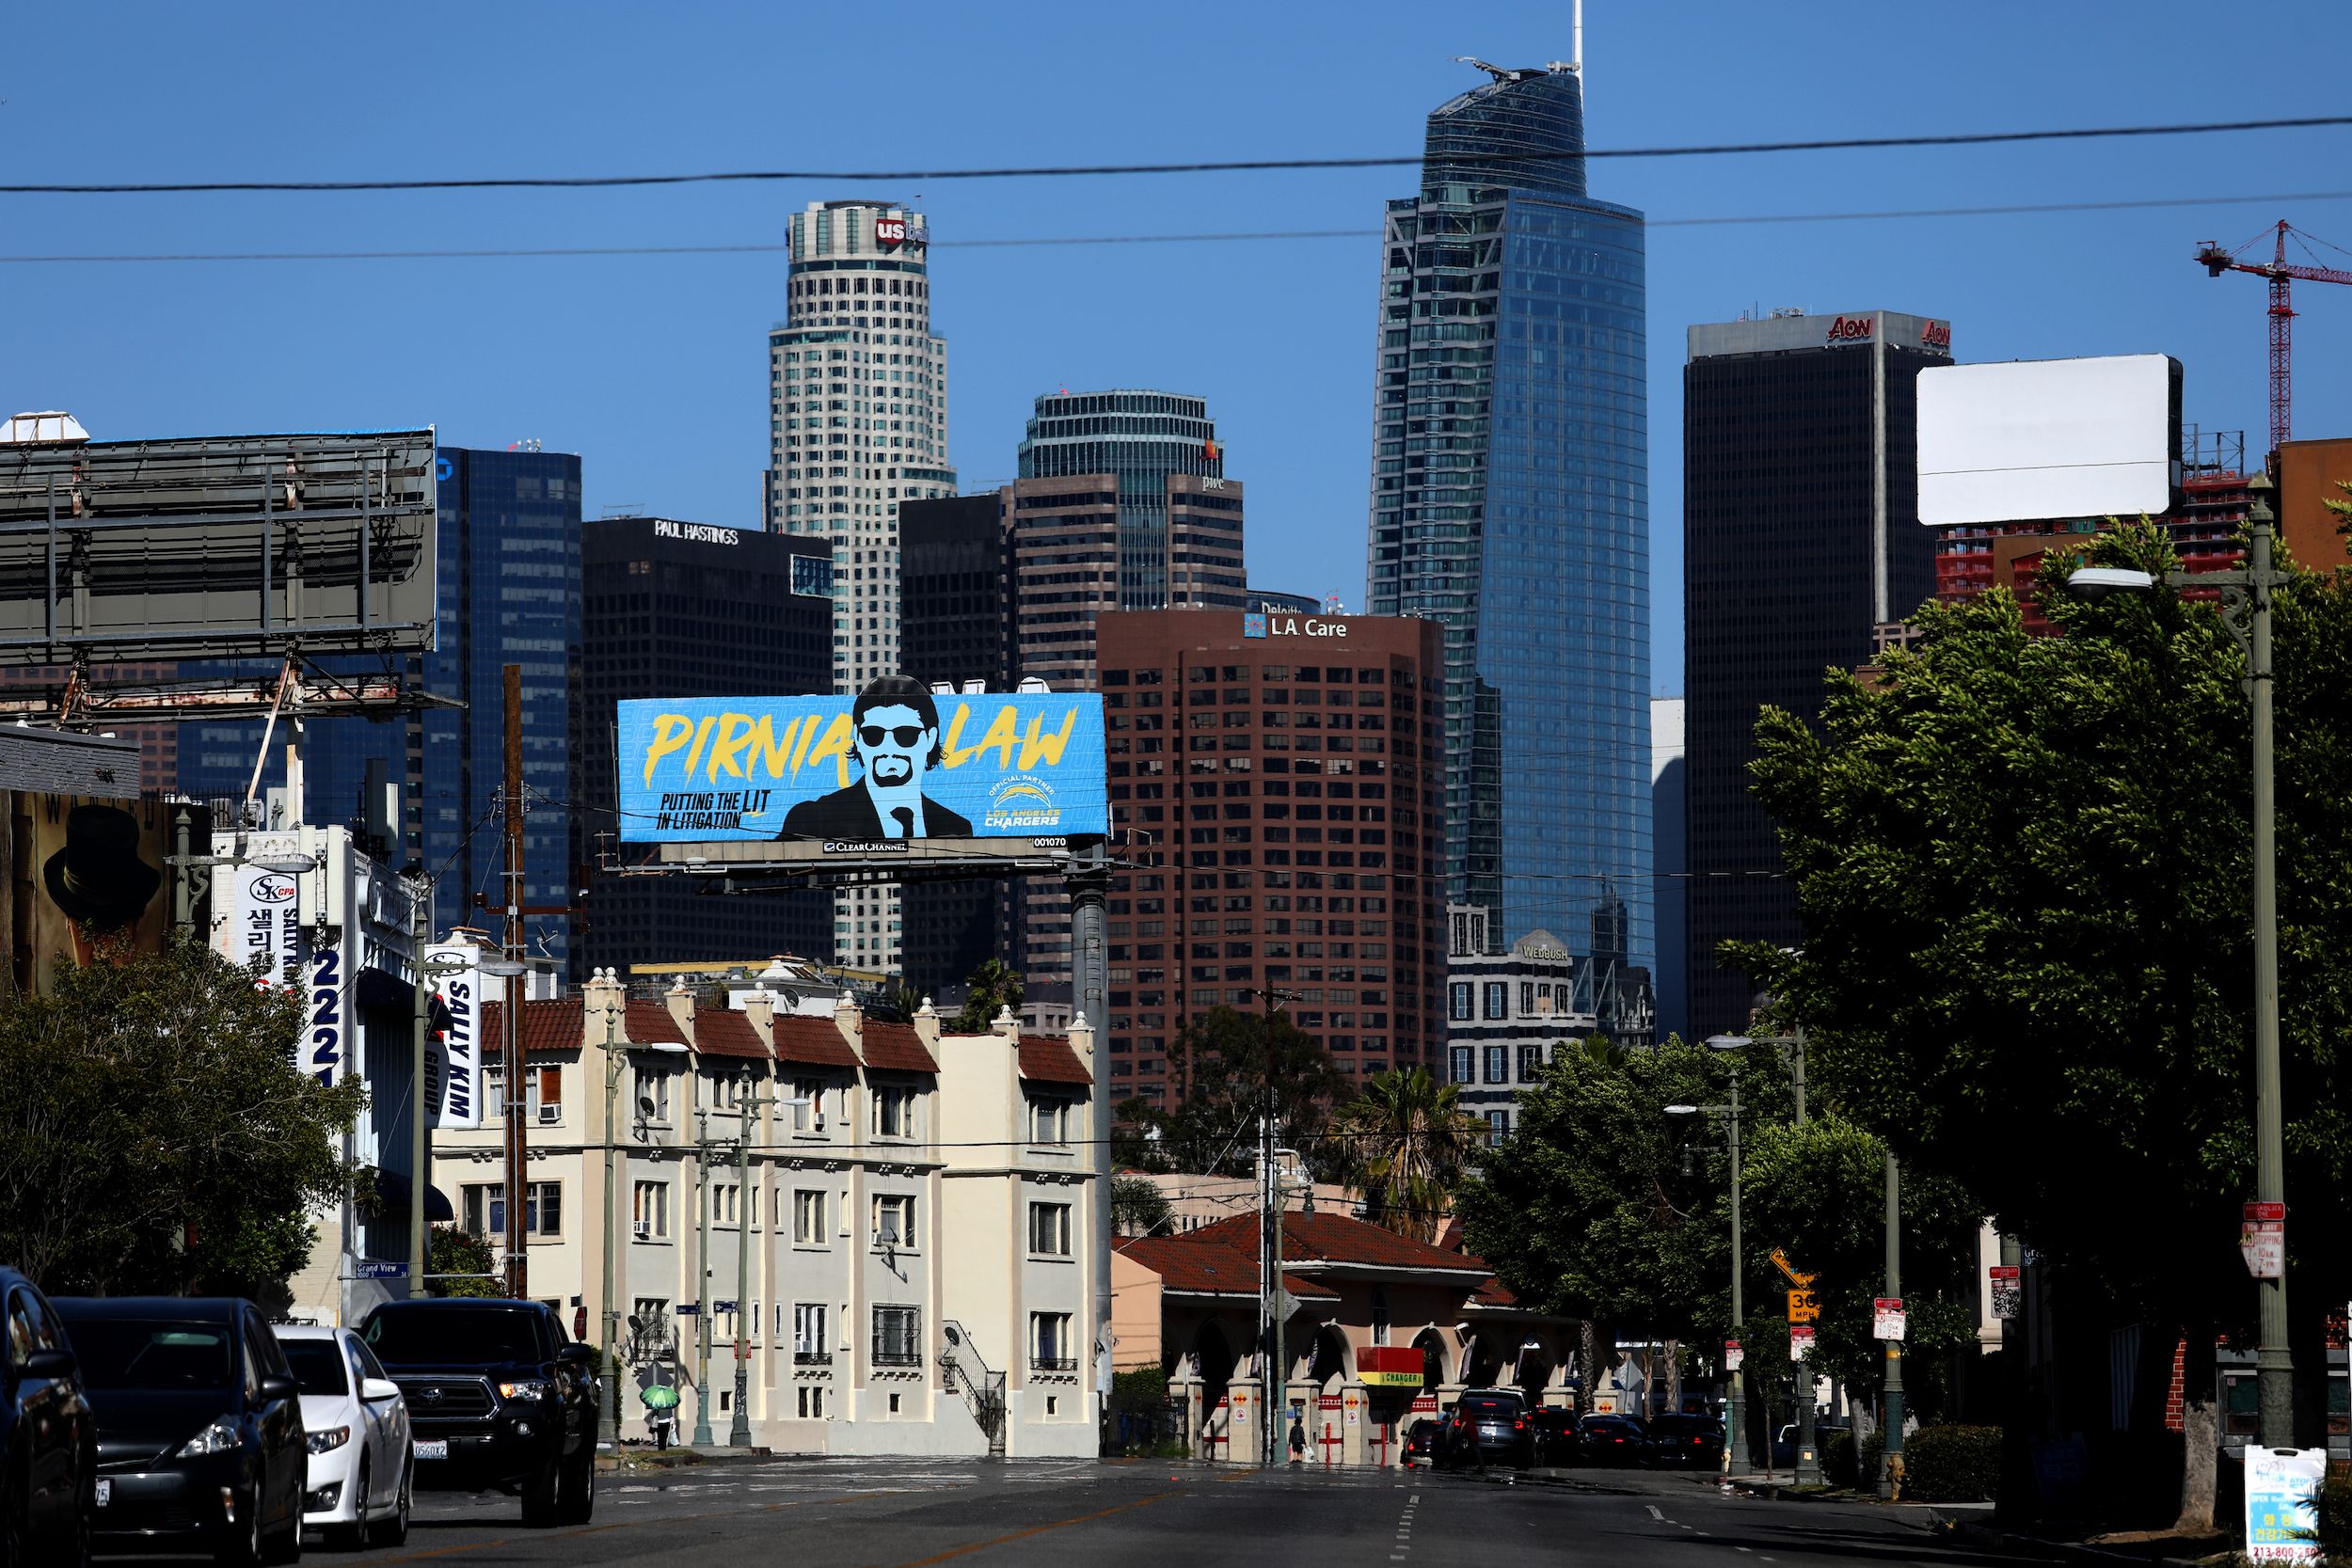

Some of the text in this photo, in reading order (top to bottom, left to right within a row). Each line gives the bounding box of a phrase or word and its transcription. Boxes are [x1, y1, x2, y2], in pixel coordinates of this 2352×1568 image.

[1202, 476, 1224, 492] pwc
[655, 520, 739, 546] PAUL HASTINGS
[1271, 618, 1346, 637] L.A. Care
[644, 703, 1078, 790] PIRNIA LAW
[989, 774, 1055, 796] OFFICIAL PARTNER
[660, 789, 771, 812] PUTTING THE LIT
[657, 812, 741, 830] IN LITIGATION
[1011, 809, 1061, 817] ANGELES
[984, 816, 1059, 830] CHARGERS
[1034, 838, 1066, 847] 001070
[1522, 945, 1567, 959] WEDBUSH
[450, 981, 469, 1118] SALLY KIM
[1386, 1373, 1417, 1383] CHANGER
